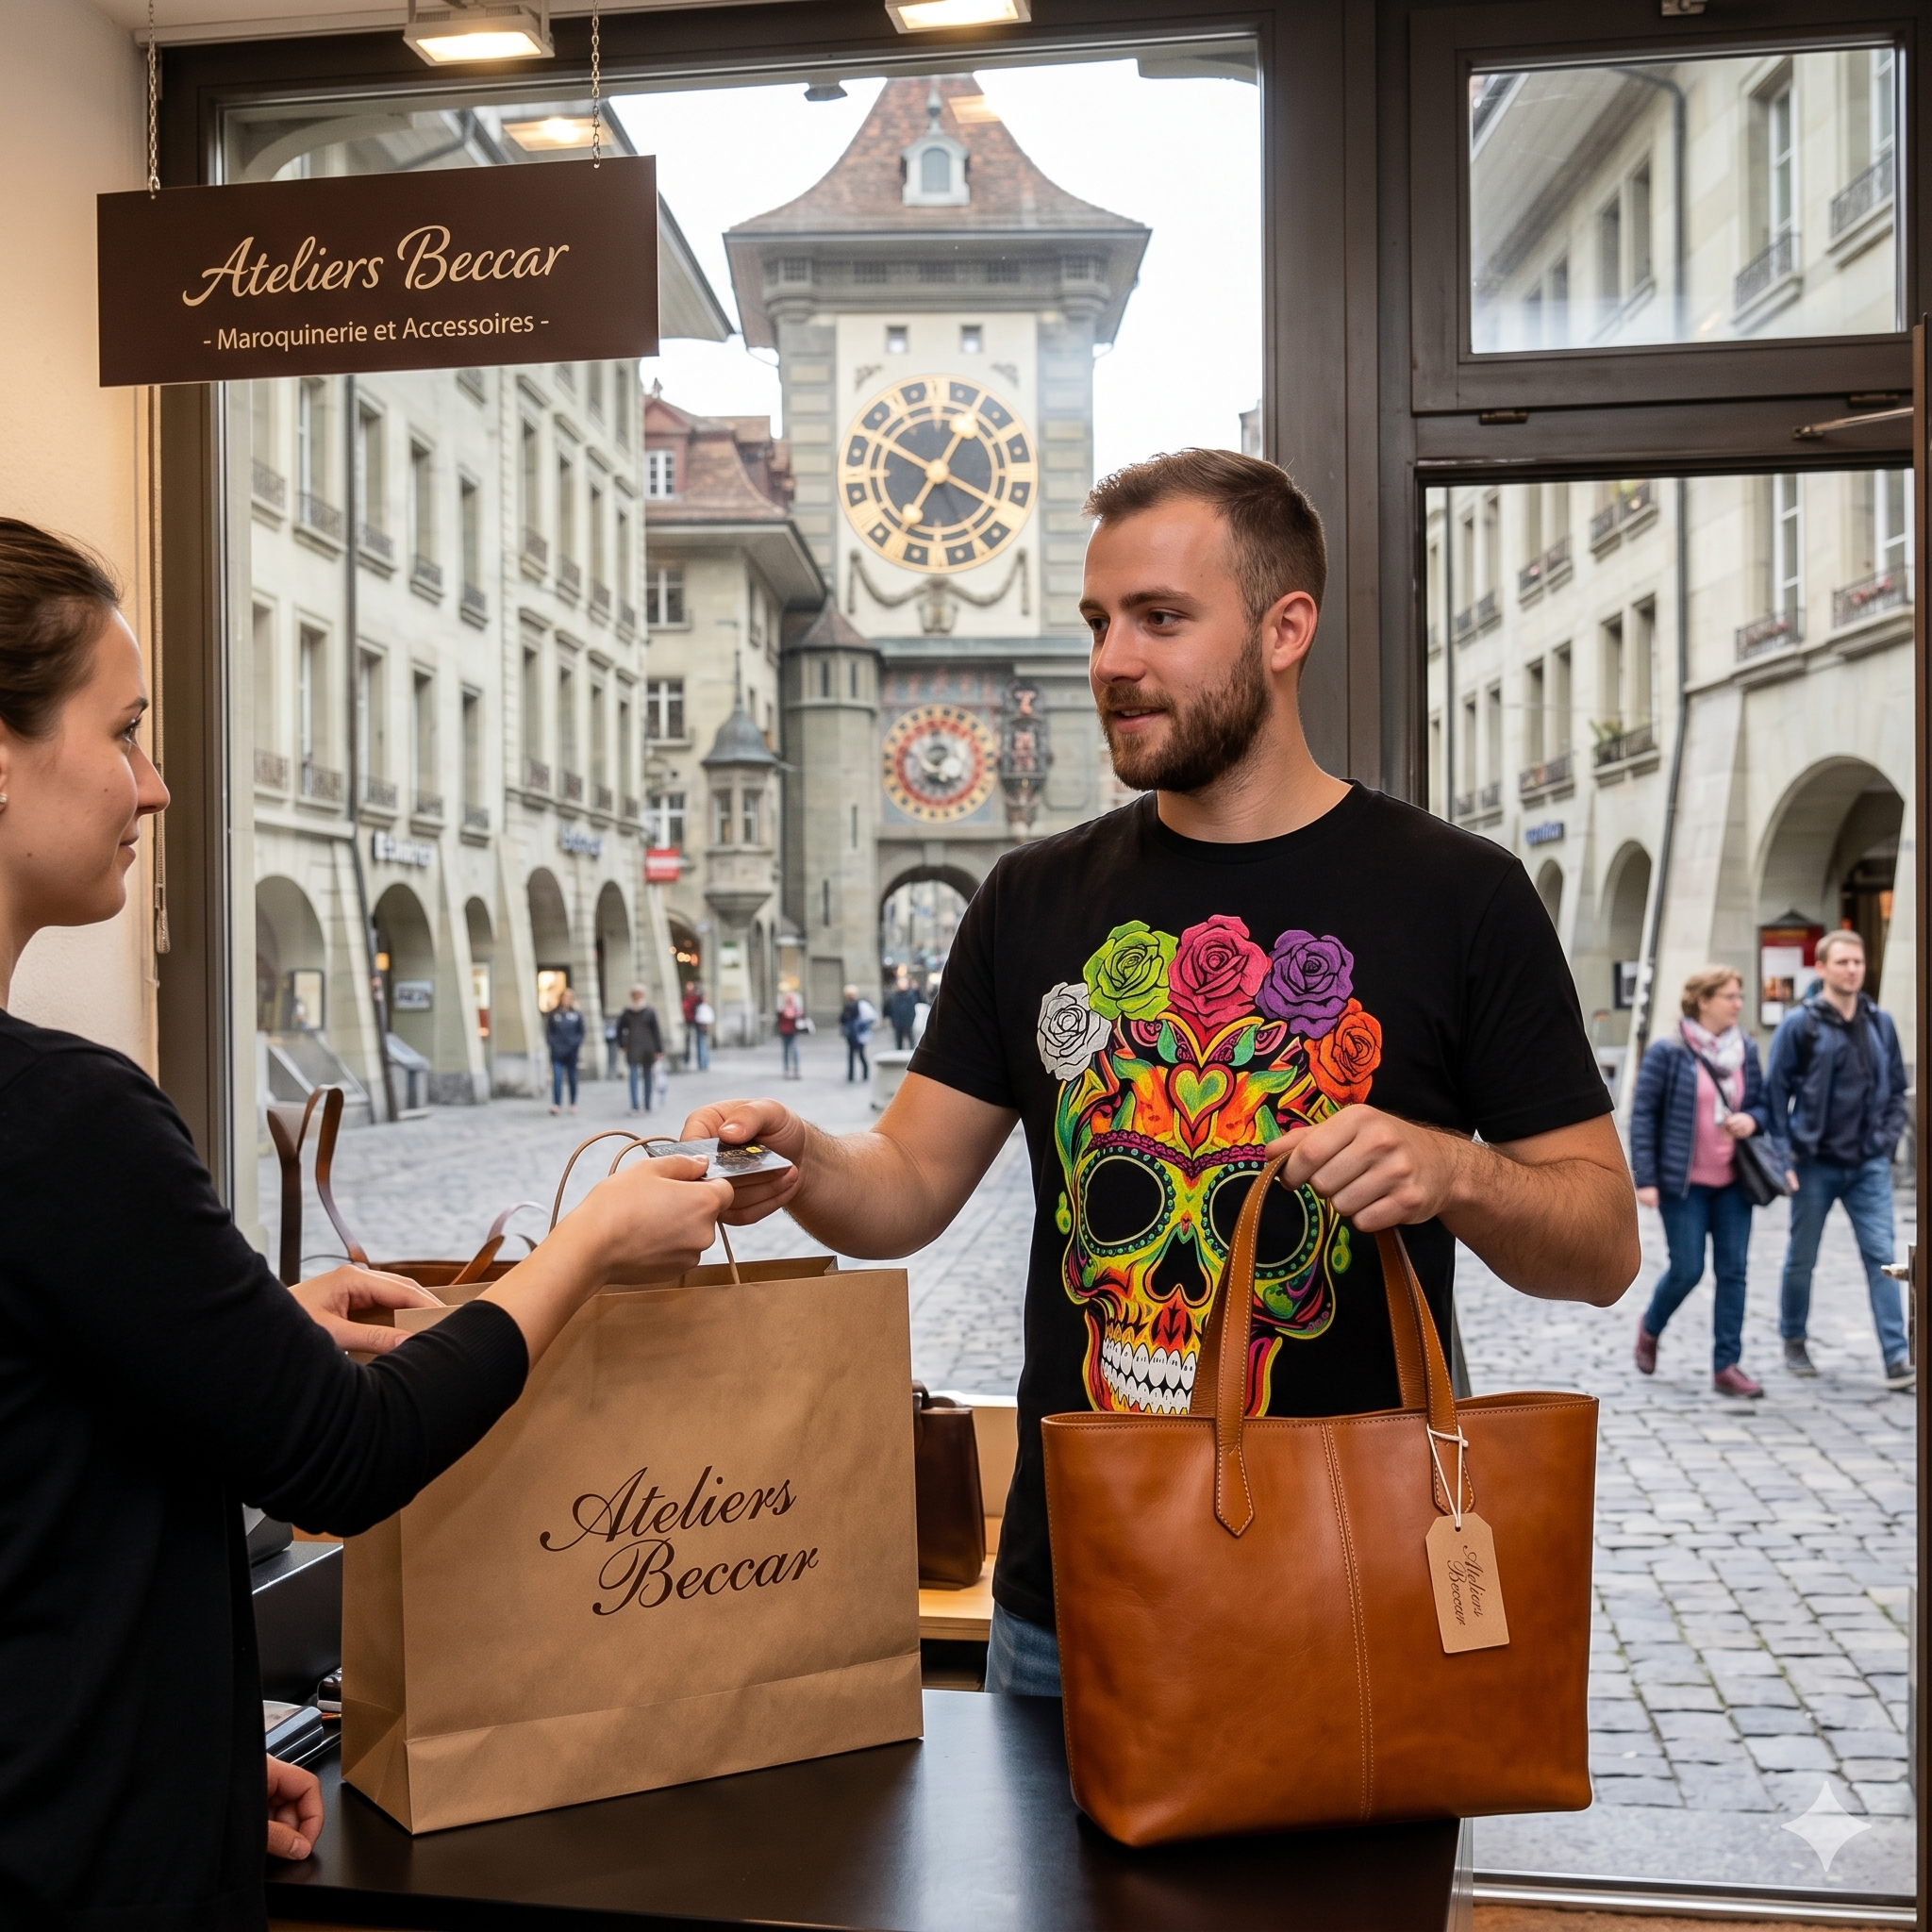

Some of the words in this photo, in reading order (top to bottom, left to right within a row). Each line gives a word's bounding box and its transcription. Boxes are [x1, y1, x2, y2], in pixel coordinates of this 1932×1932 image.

[182, 235, 384, 307] Ateliers
[397, 225, 570, 291] Beccar
[217, 321, 368, 352] Maroquinerie
[374, 321, 397, 341] et
[403, 312, 535, 340] Accessoires
[539, 1465, 797, 1553] Ateliers
[591, 1537, 820, 1616] Beccar
[1447, 1559, 1466, 1625] Beccar
